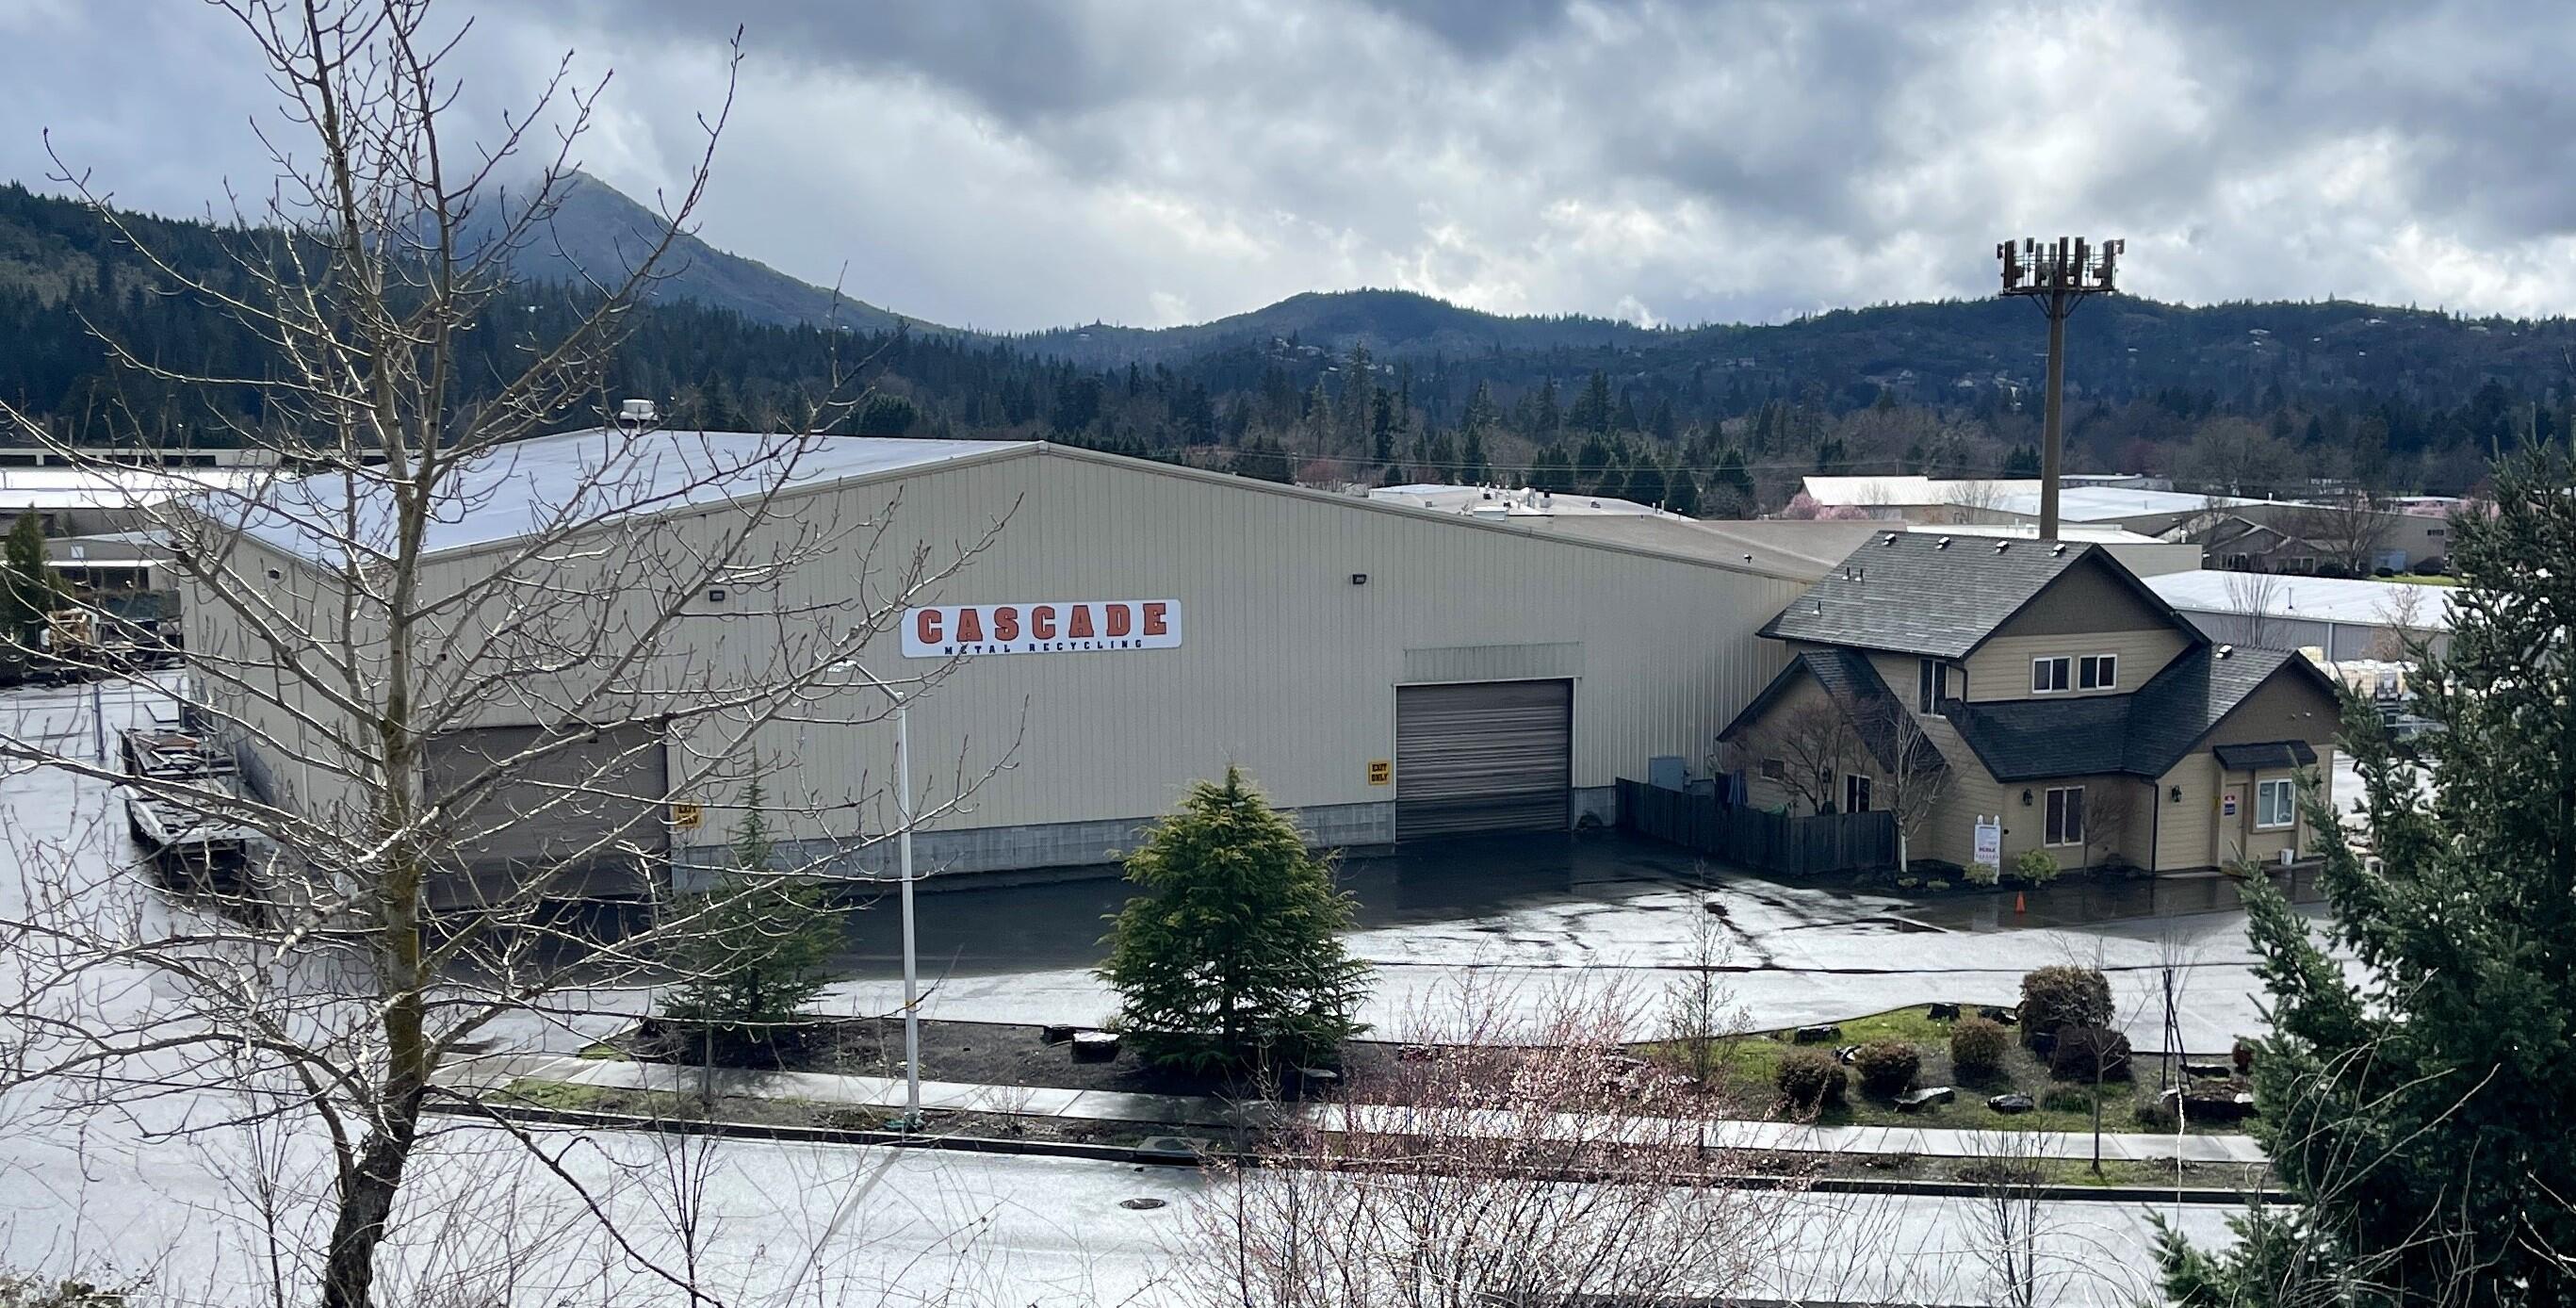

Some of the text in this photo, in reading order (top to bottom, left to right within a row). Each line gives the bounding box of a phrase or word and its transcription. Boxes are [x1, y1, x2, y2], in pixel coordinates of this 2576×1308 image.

[917, 603, 1167, 644] CASCADE
[945, 640, 1143, 655] METAL RECYCLING
[1372, 763, 1387, 772] EXIT
